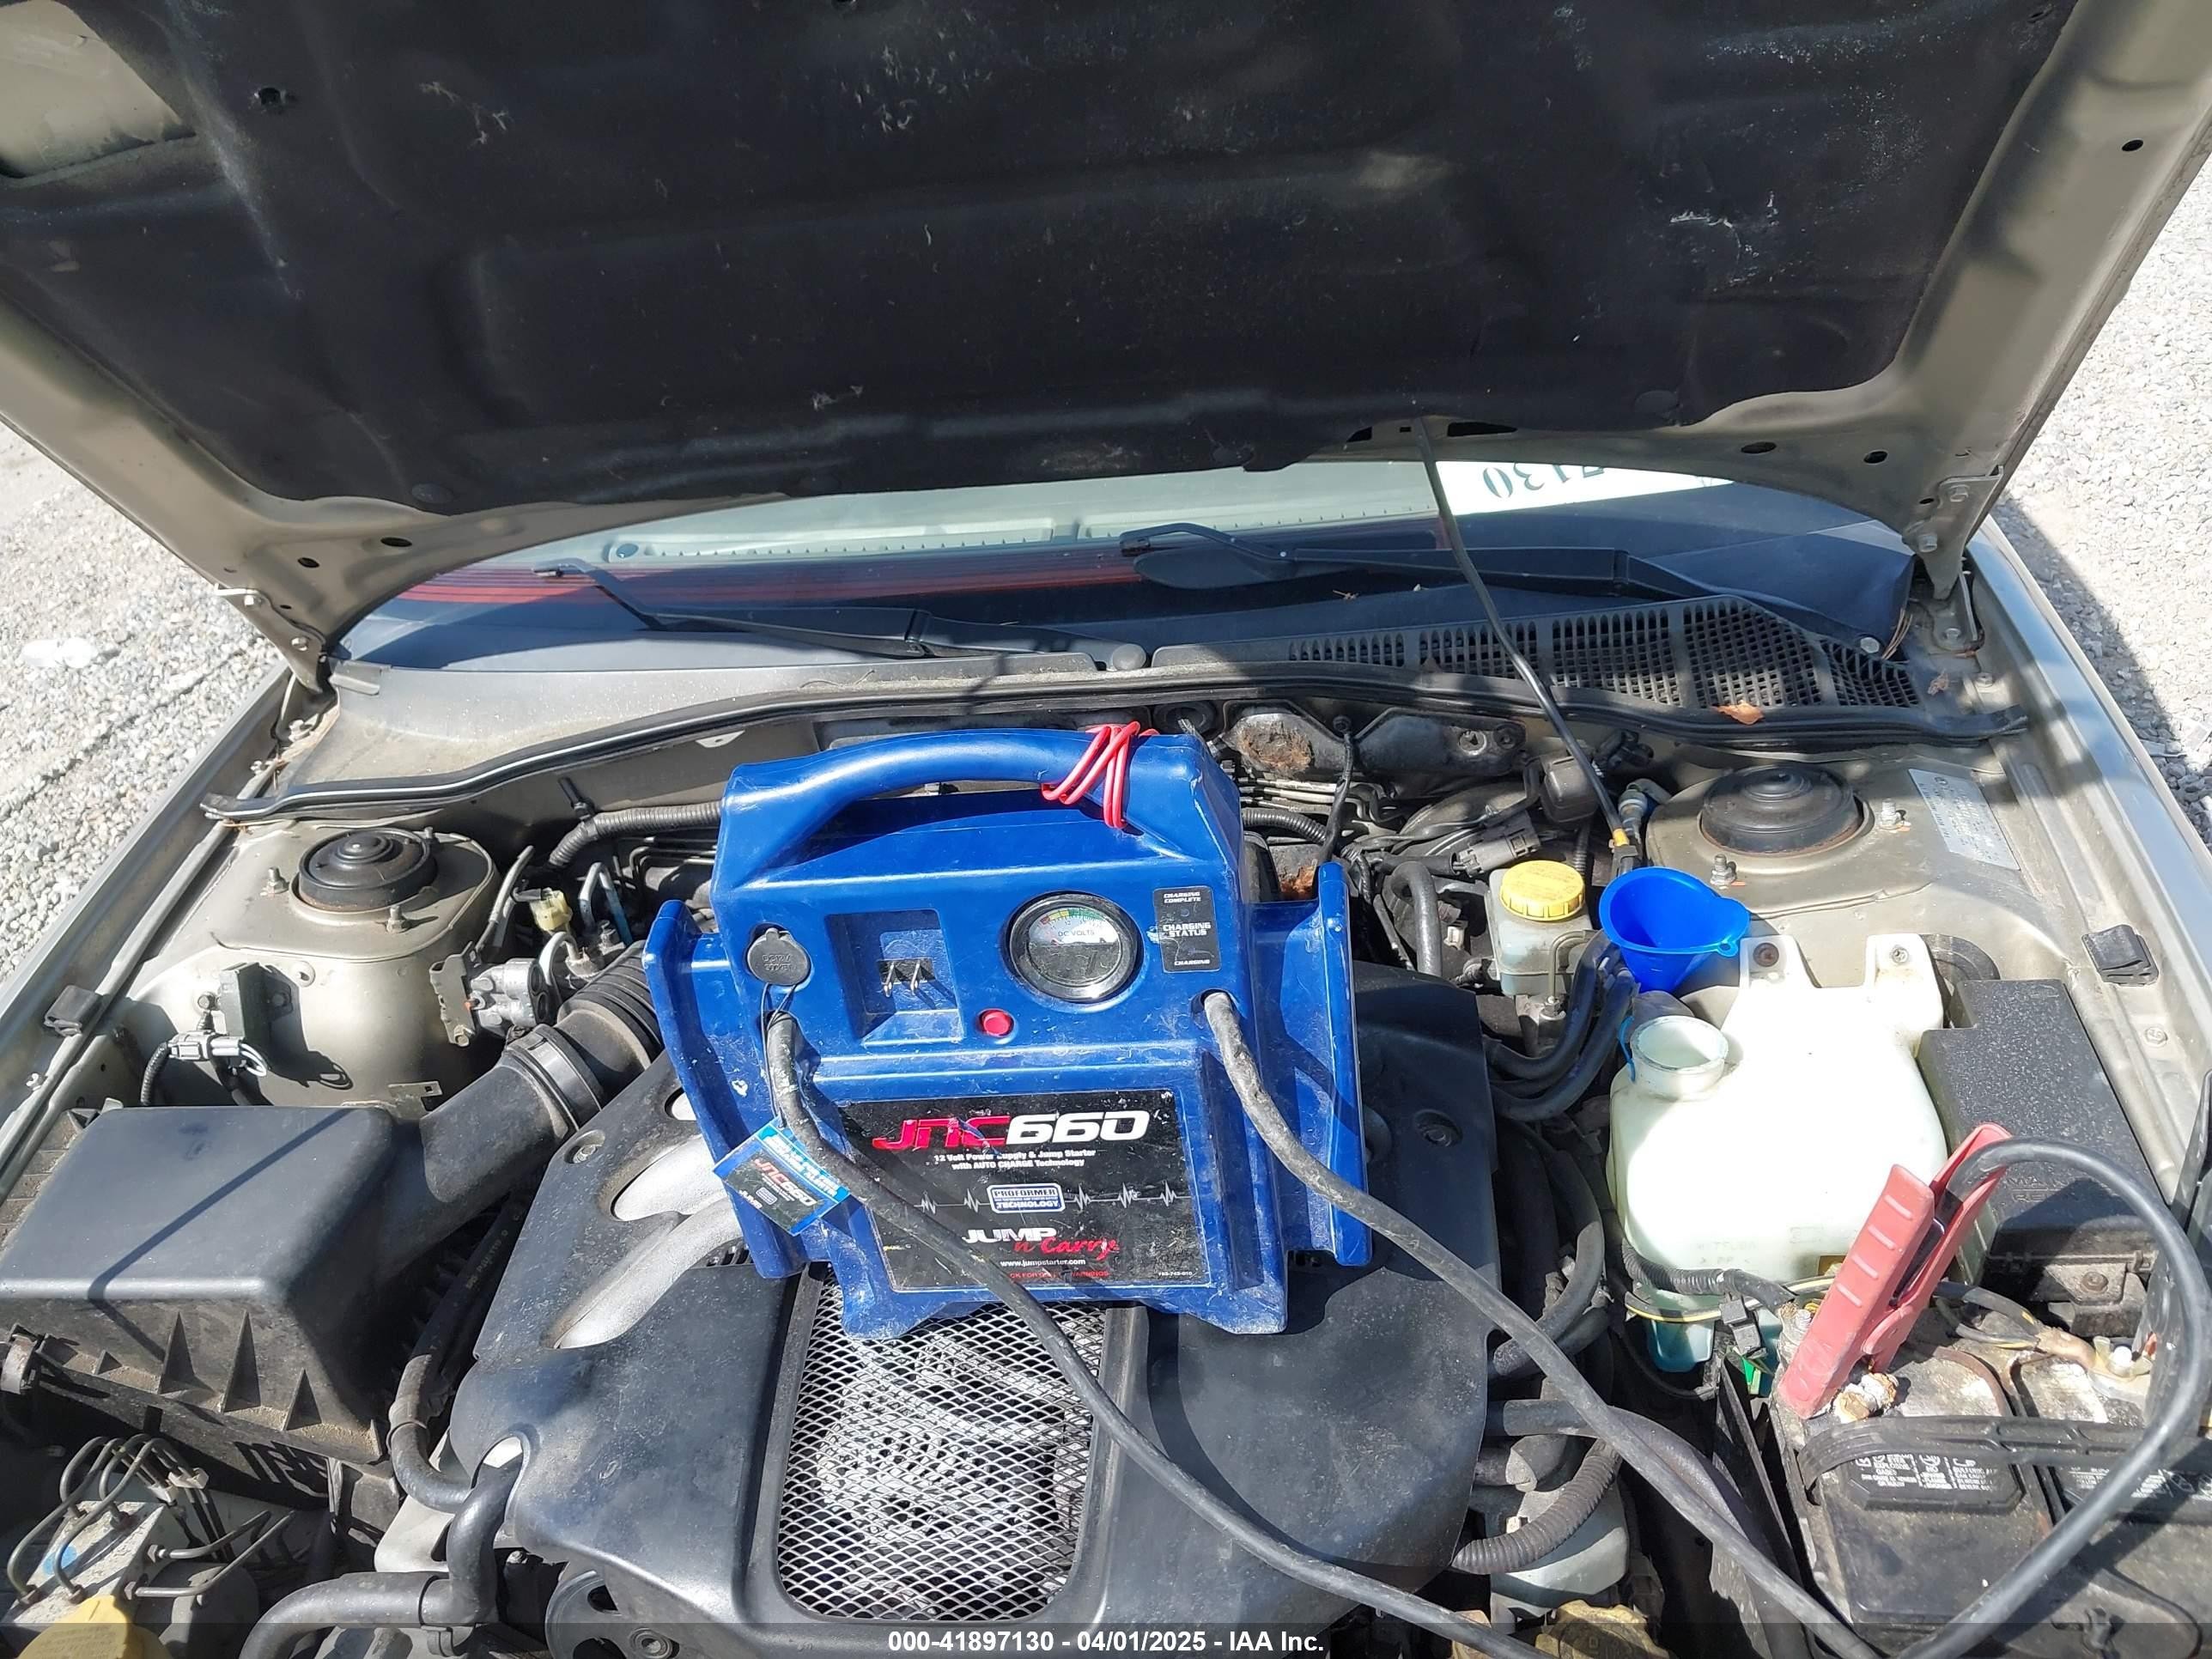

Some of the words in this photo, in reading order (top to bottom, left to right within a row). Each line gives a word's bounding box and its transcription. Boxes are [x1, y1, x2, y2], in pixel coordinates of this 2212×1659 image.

[1163, 921, 1212, 932] CHARGING
[1169, 929, 1207, 938] STATUS
[872, 1110, 1150, 1151] JNC660
[946, 1153, 964, 1162] Volt
[966, 1152, 994, 1161] Power
[1037, 1151, 1064, 1159] Jump
[951, 1162, 973, 1170] with
[998, 1160, 1034, 1169] CHARGE
[1035, 1158, 1085, 1167] Technology
[994, 1188, 1055, 1197] PROFORMER
[995, 1200, 1060, 1209] TECHNOLOGY
[961, 1227, 1057, 1244] JUMP
[1000, 1259, 1086, 1267] www.jumpstarter.com
